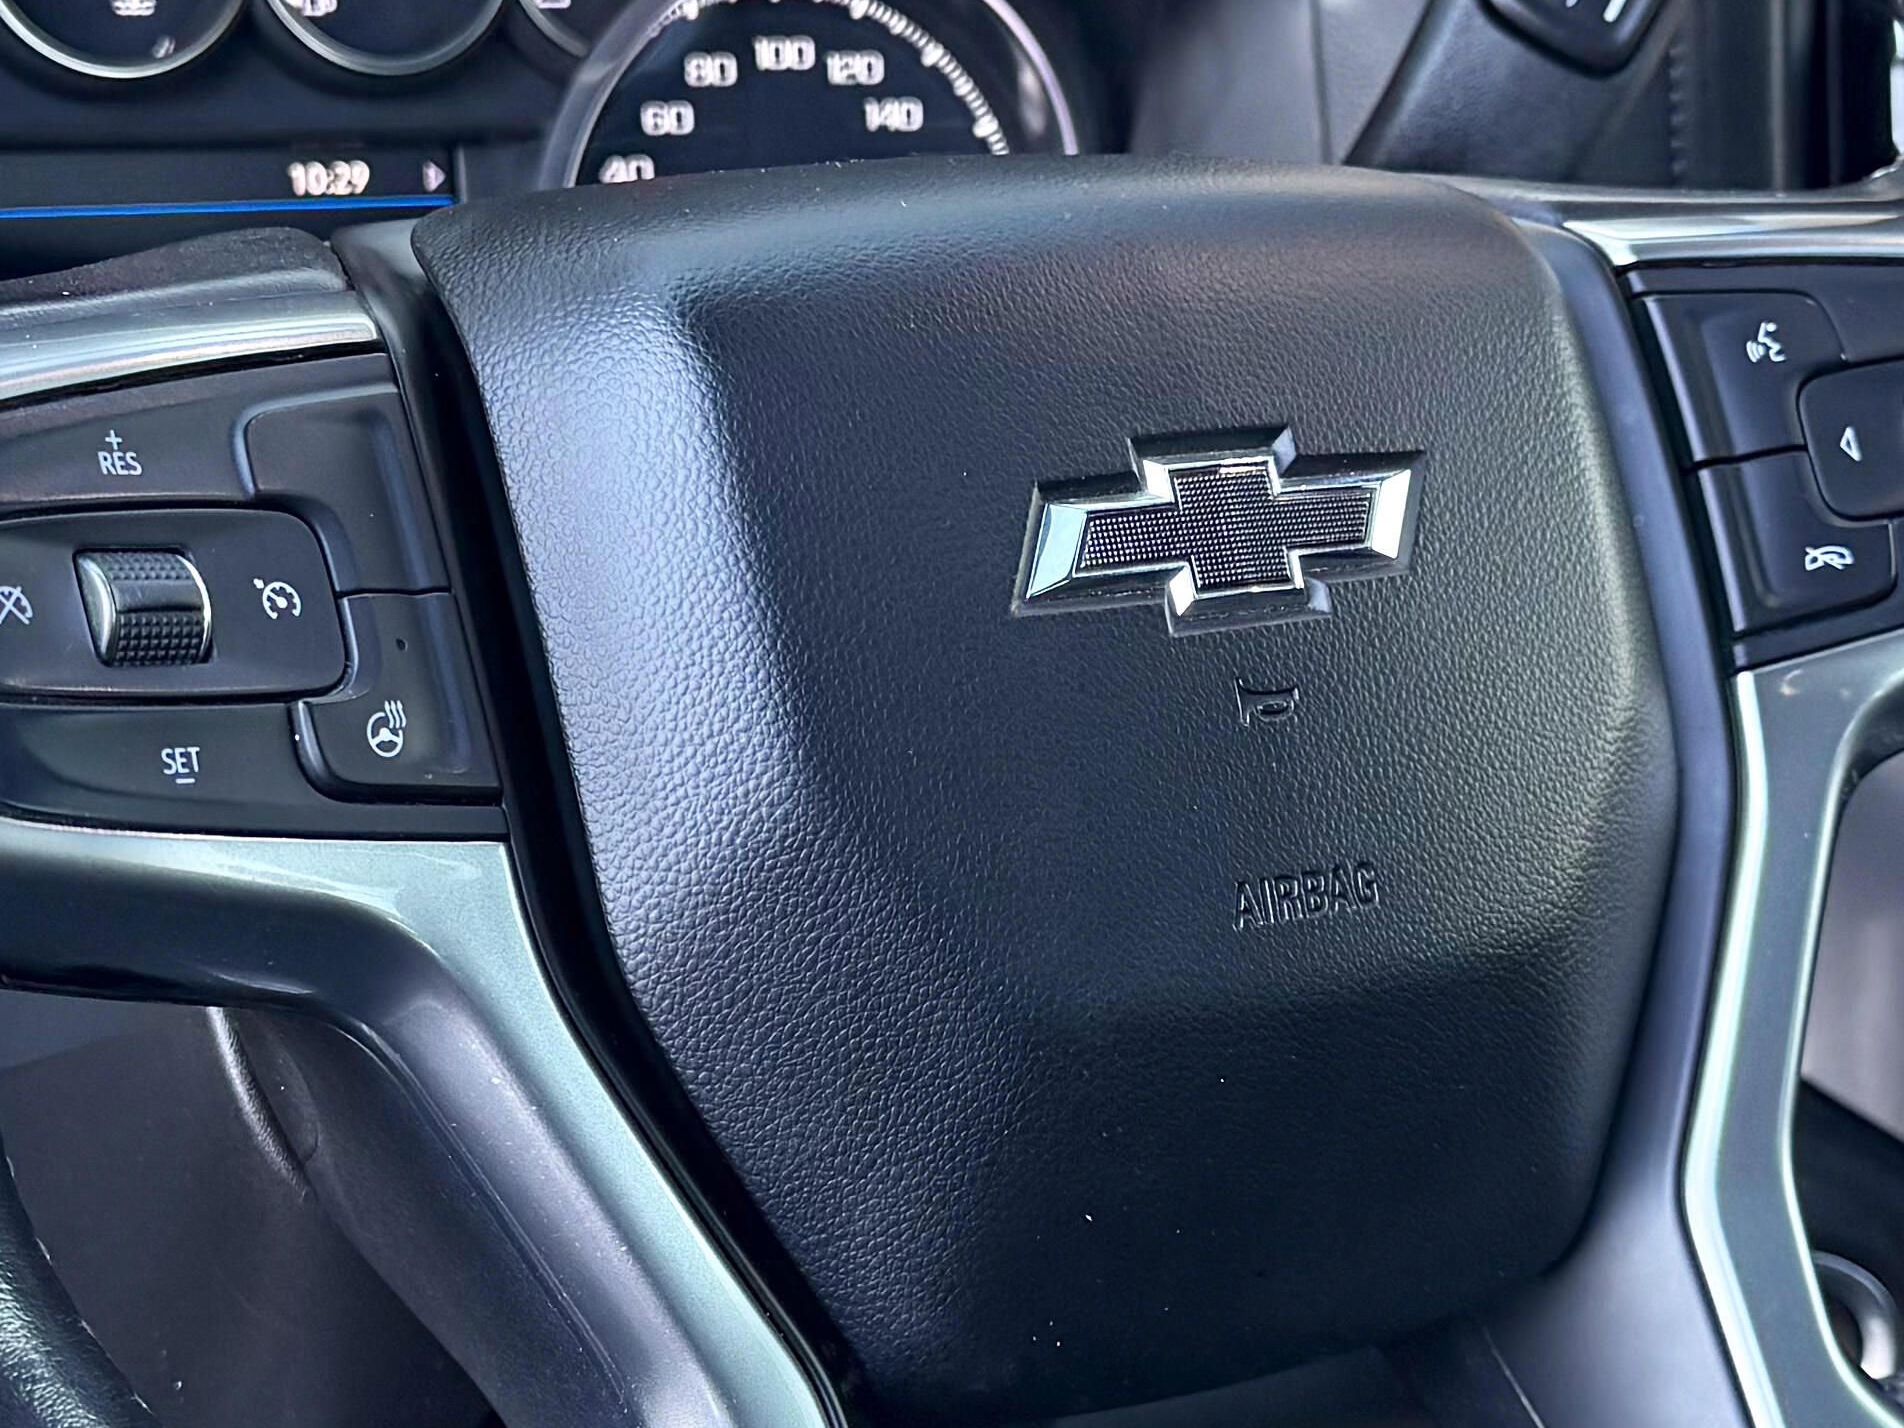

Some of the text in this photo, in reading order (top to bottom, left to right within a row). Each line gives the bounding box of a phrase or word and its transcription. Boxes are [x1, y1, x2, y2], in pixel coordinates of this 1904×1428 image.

[684, 51, 738, 87] 80
[752, 35, 816, 71] 100
[823, 49, 885, 86] 120
[640, 100, 695, 136] 60
[863, 96, 924, 132] 140
[287, 160, 370, 197] 10:29
[97, 451, 142, 476] RES
[161, 748, 201, 775] SET
[1232, 861, 1380, 931] AIRBAG
